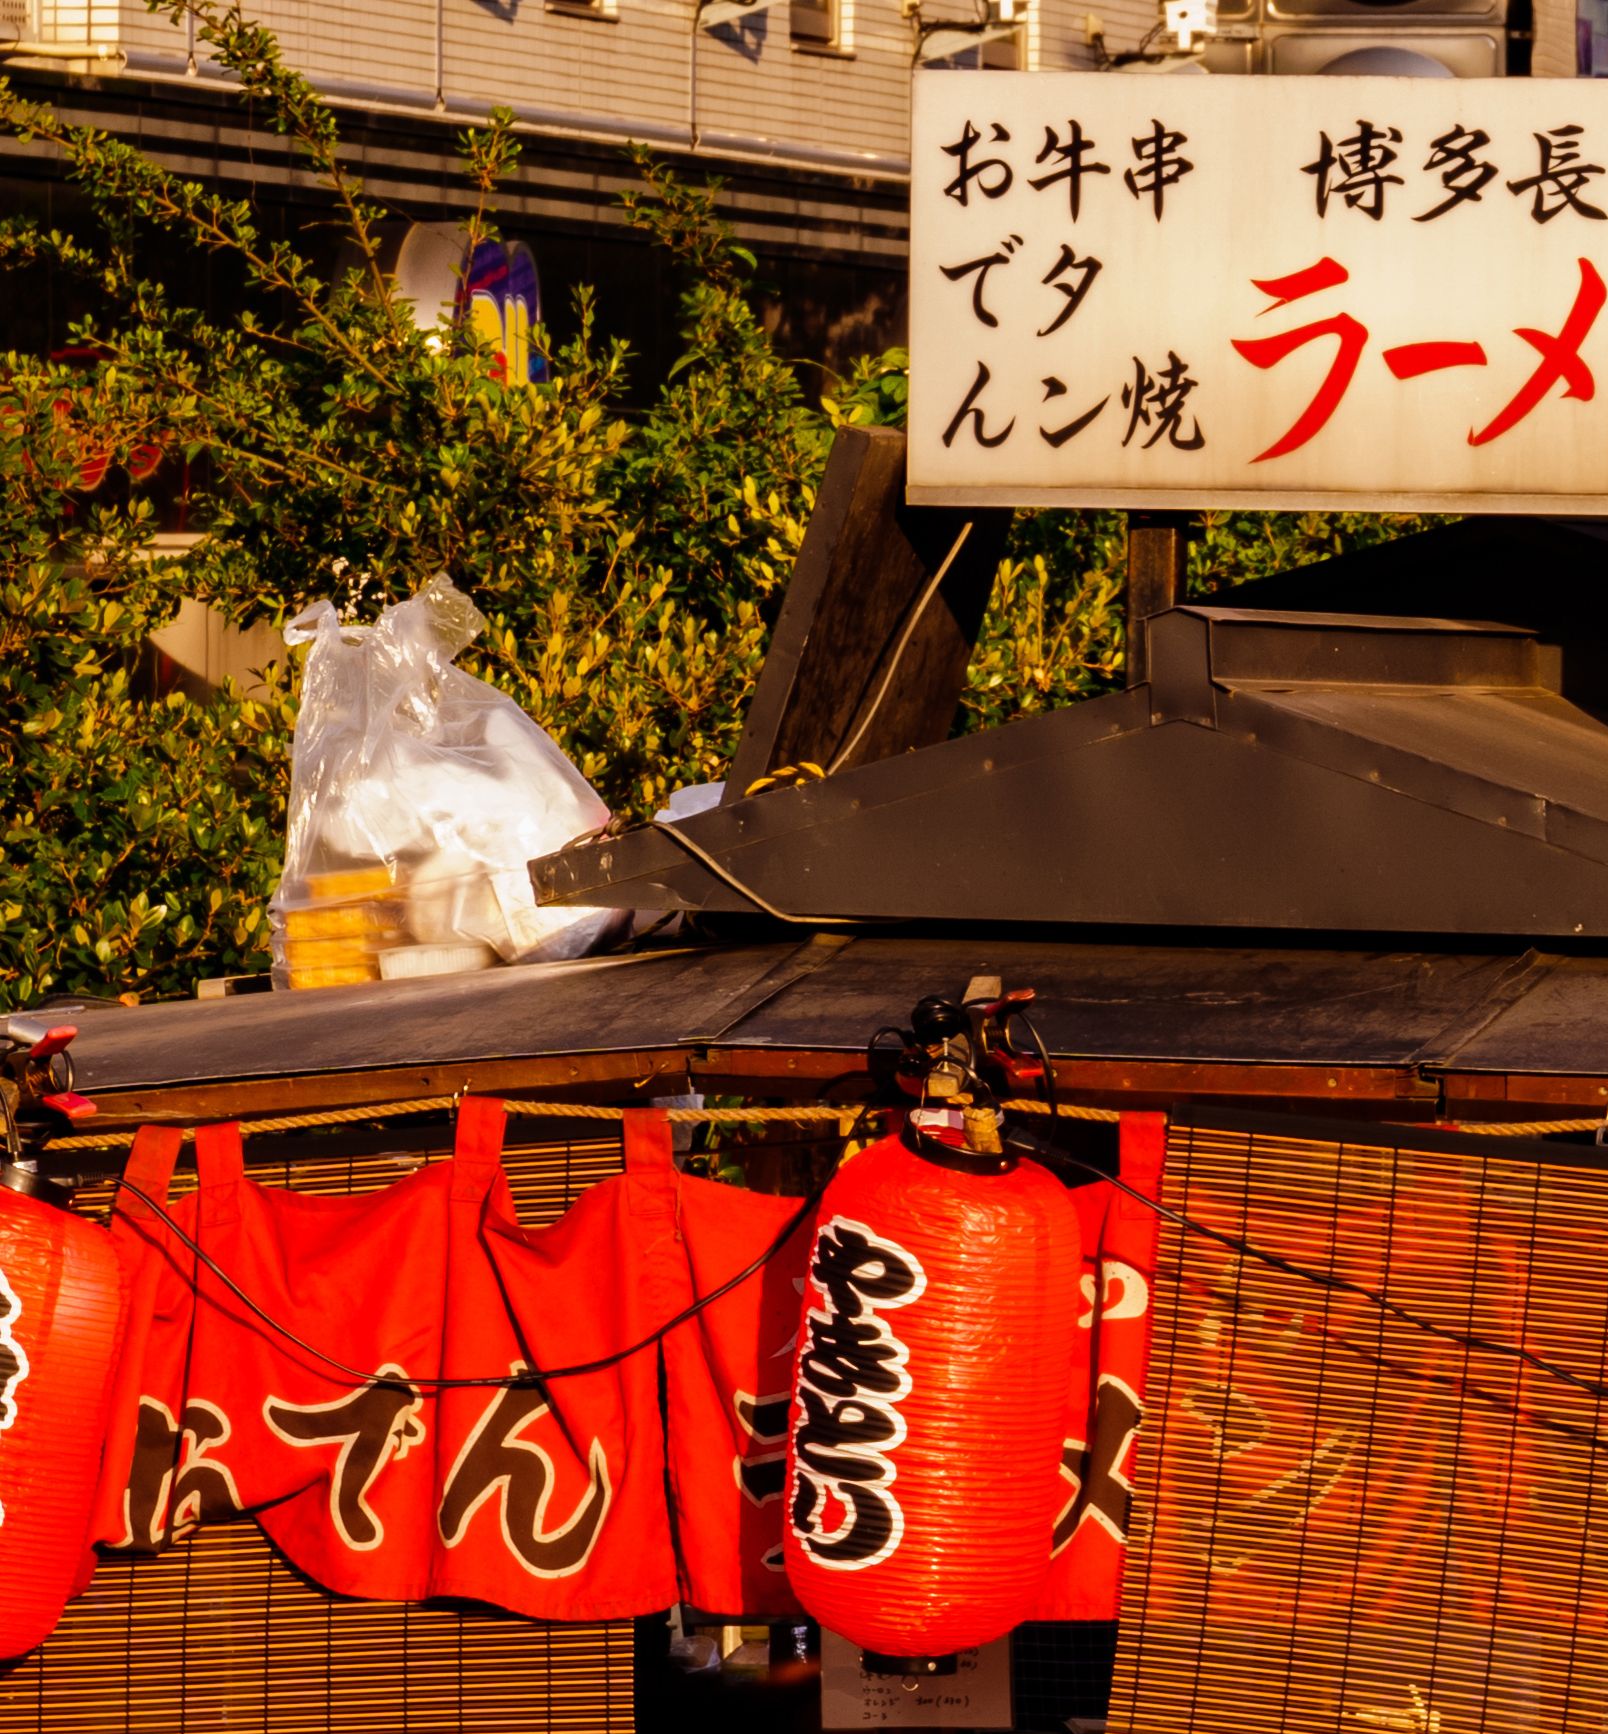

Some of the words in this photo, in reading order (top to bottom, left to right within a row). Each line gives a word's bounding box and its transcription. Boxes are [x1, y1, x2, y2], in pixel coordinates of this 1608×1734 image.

[941, 120, 1023, 450] おでん
[1029, 118, 1111, 448] 牛タン
[1121, 117, 1207, 452] 串焼
[788, 1215, 928, 1571] やきとり
